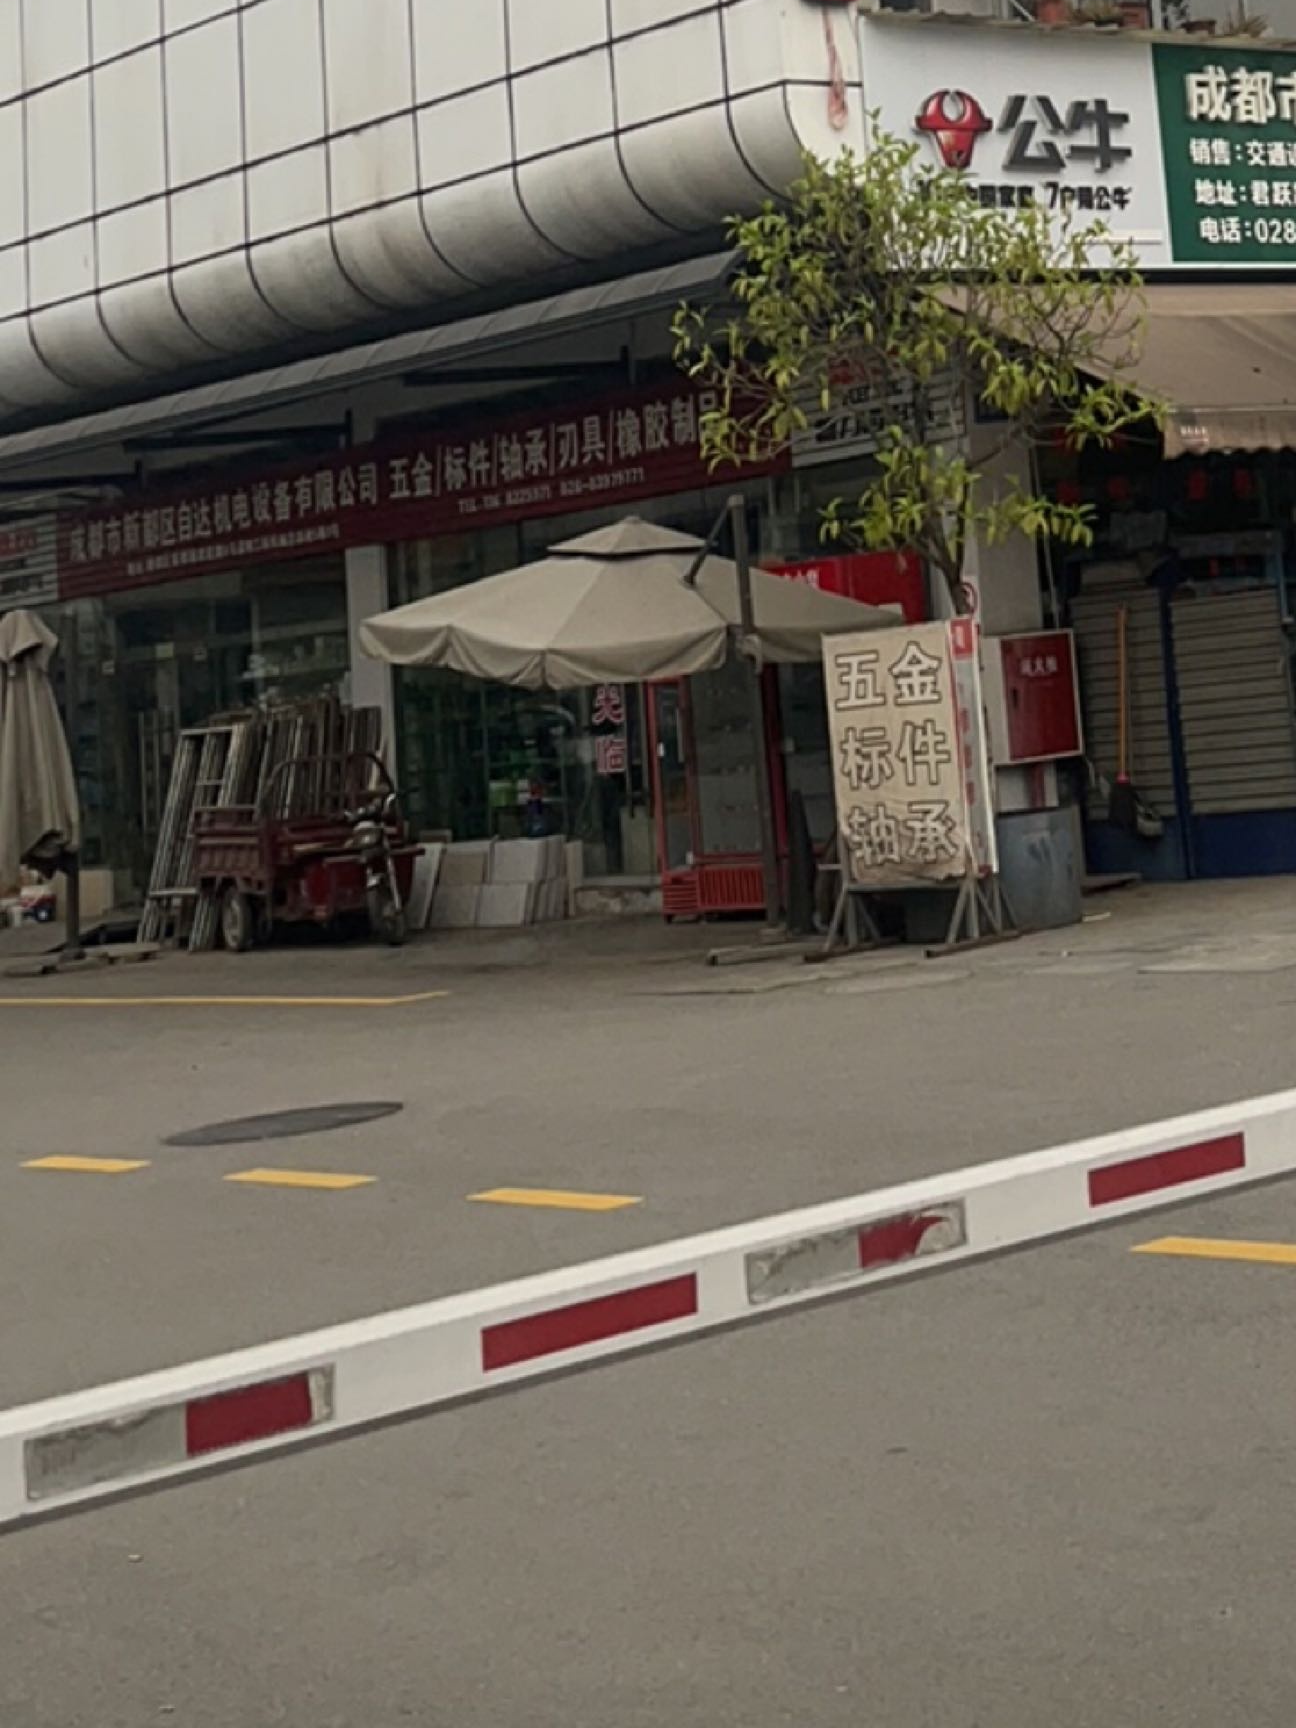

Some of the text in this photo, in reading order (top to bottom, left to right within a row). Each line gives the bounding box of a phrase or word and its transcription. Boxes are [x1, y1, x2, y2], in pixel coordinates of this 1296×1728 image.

[997, 94, 1133, 173] 公牛
[834, 640, 943, 713] 五金
[839, 719, 952, 790] 标件
[847, 800, 959, 867] 轴承
